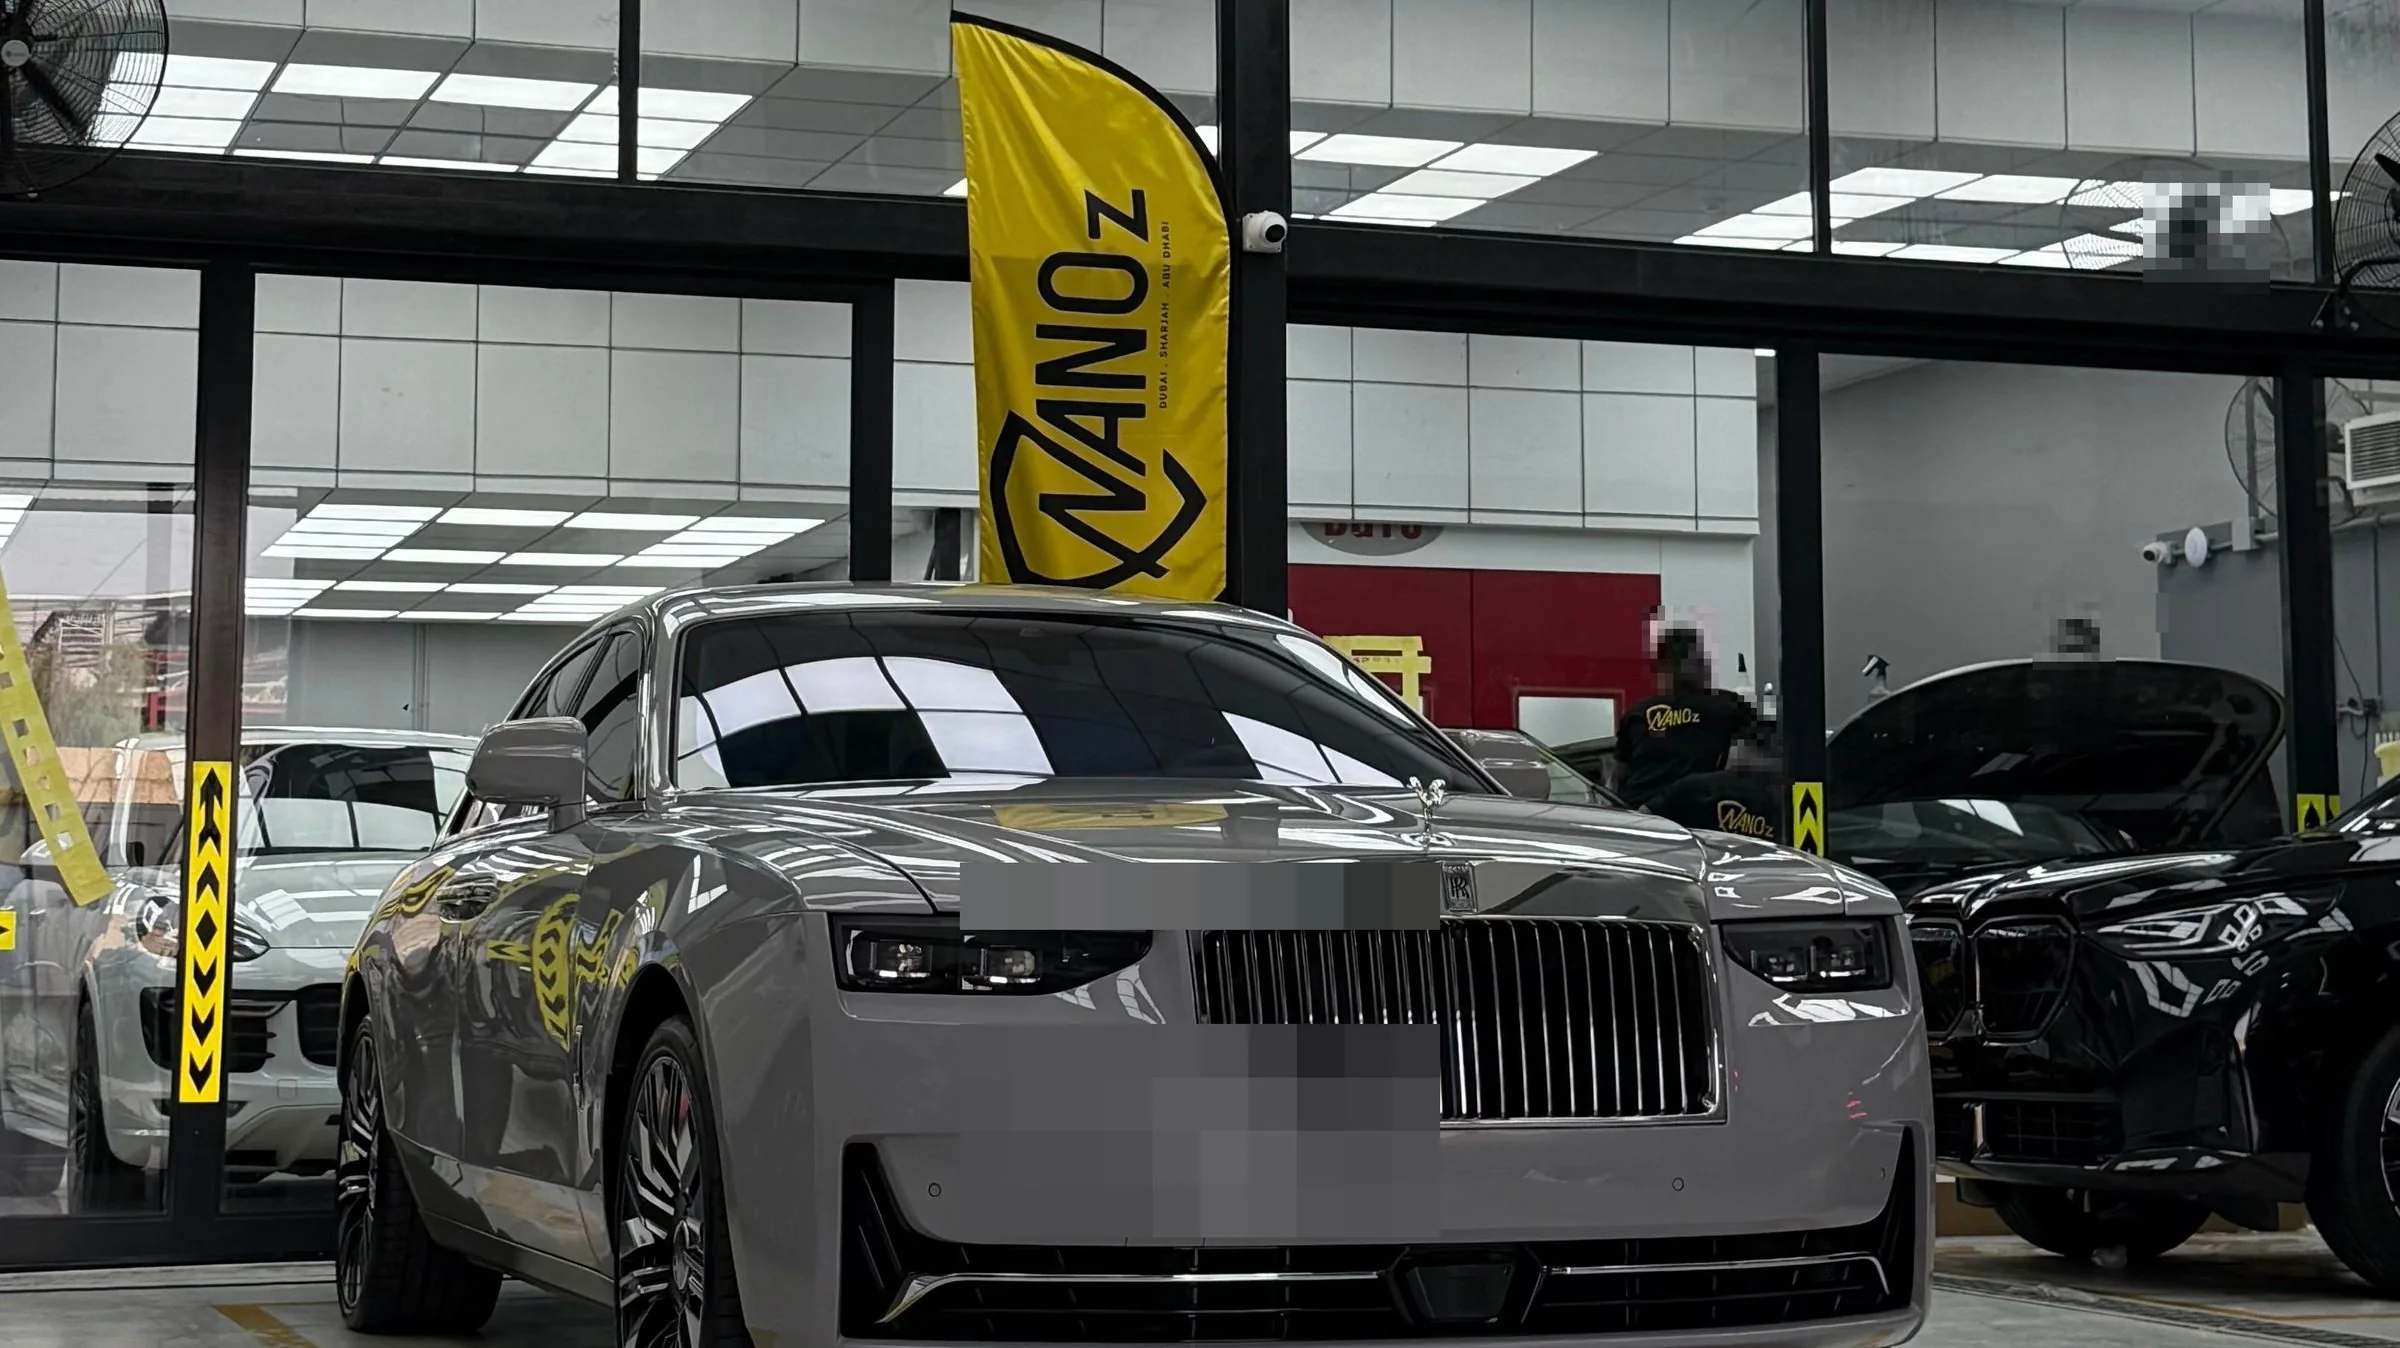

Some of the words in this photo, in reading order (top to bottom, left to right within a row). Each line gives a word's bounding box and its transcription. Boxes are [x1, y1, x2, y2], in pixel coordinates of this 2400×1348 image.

[1161, 221, 1171, 258] DHABI
[1162, 264, 1171, 289] ABU
[1160, 303, 1170, 358] SHARJAH
[1159, 371, 1168, 409] DUBAI
